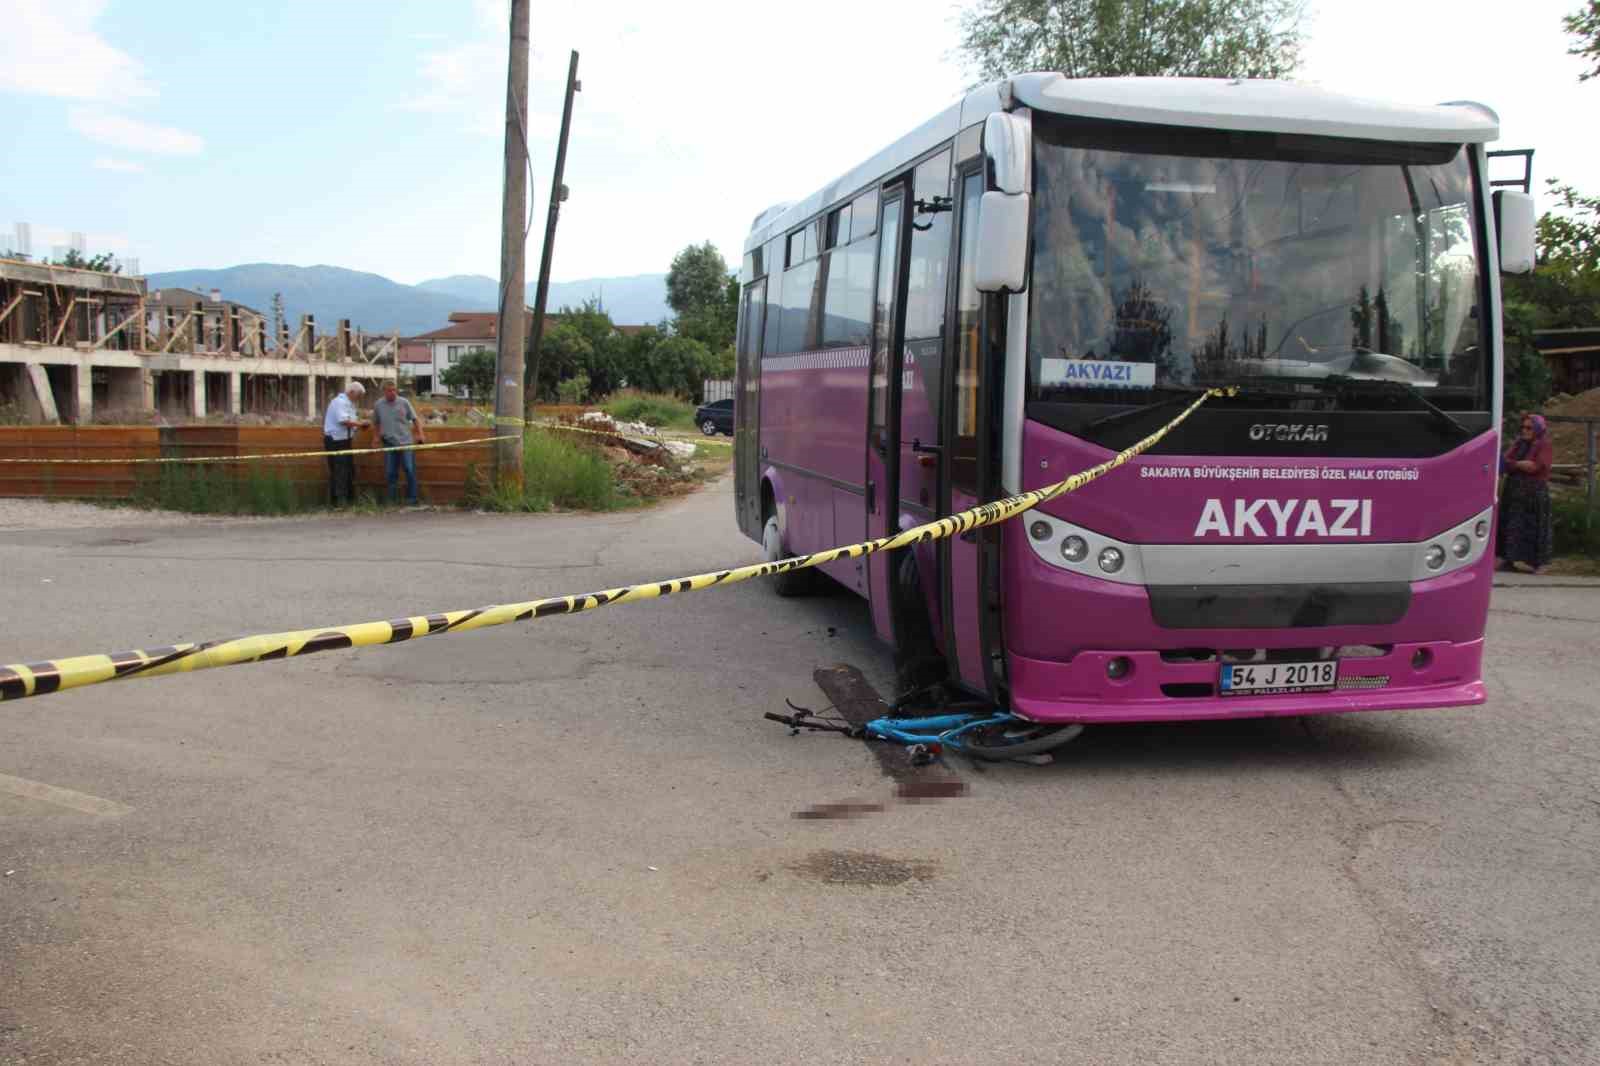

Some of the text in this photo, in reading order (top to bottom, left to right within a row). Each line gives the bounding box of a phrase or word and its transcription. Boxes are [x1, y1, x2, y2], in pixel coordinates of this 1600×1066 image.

[1066, 363, 1131, 380] AKYAZI
[1249, 424, 1328, 441] OTOKAR
[1141, 465, 1419, 481] SAKARYA BÜYÜKŞEHİR BELEDİYESİ ÖZEL HALK OTOBÜSÜ
[1194, 499, 1372, 536] AKYAZI
[1233, 665, 1333, 686] 54 J 2018
